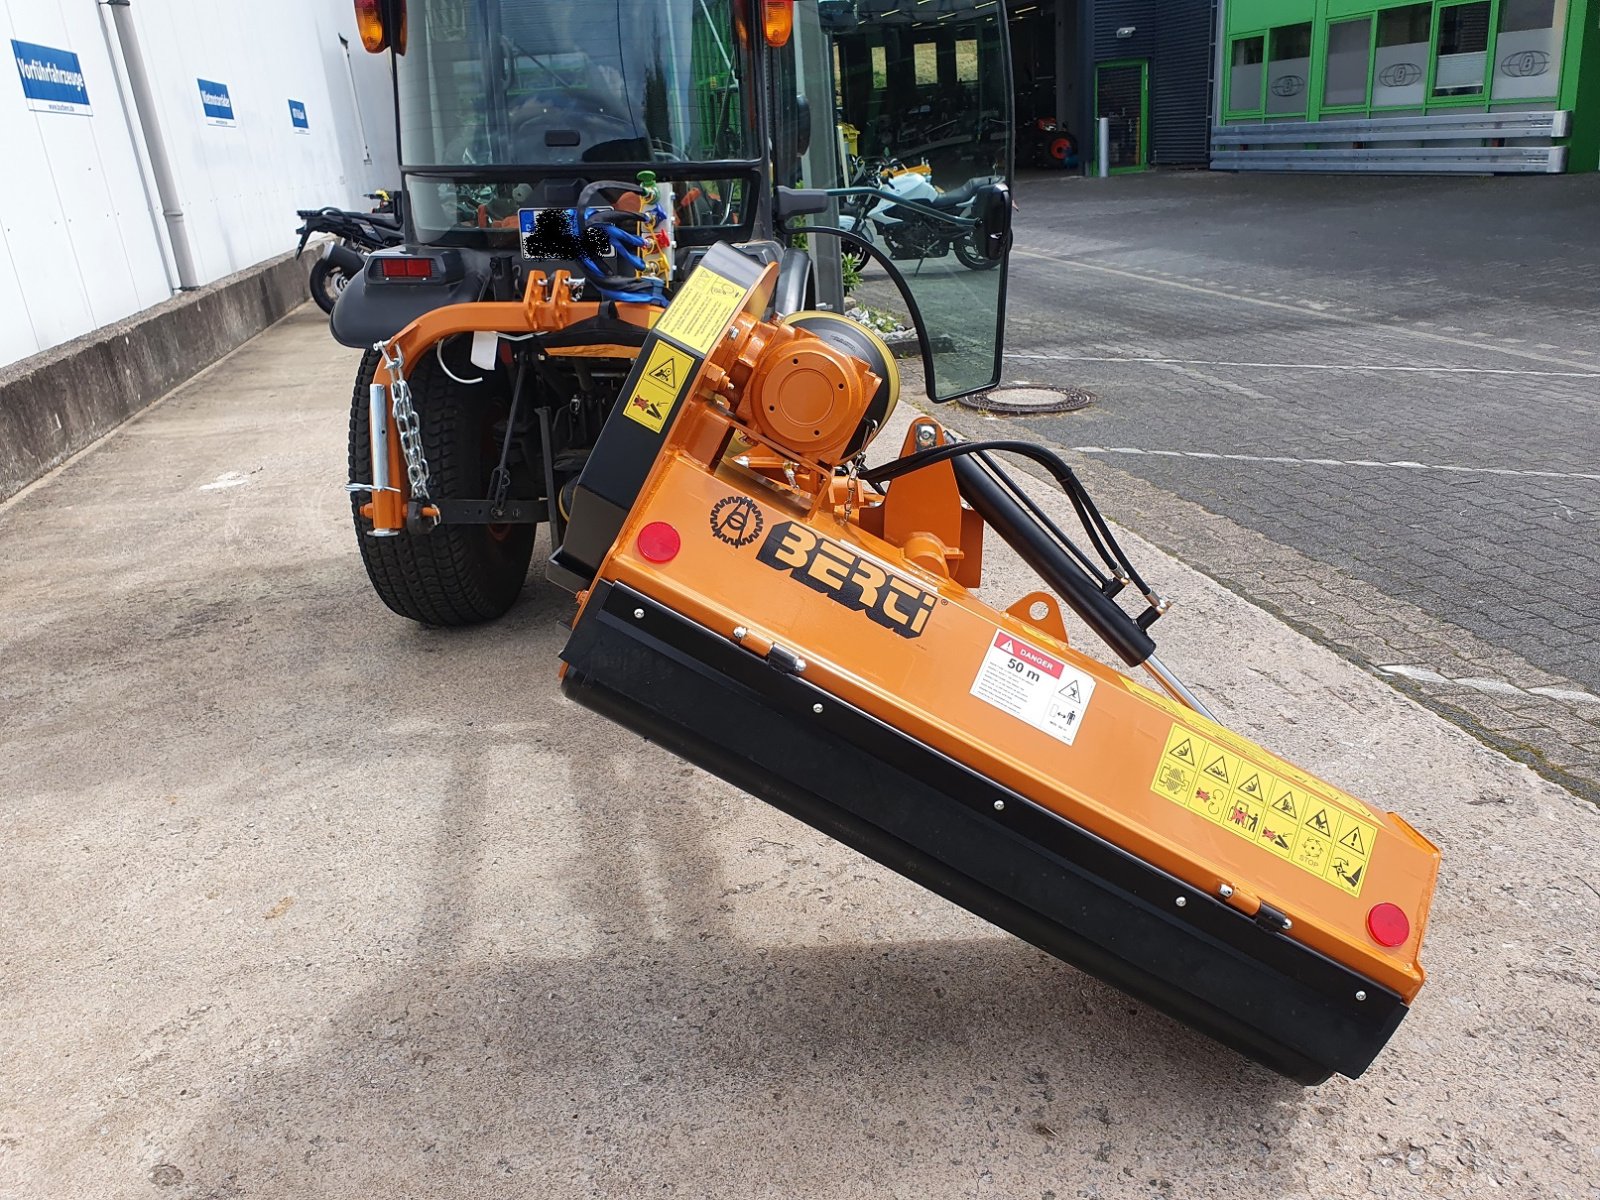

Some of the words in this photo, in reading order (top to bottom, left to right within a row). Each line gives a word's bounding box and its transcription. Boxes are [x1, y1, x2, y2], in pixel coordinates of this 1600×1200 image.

[17, 57, 84, 91] Vorführfahrzeuge
[1007, 658, 1024, 673] 50
[1026, 669, 1040, 682] m
[1020, 648, 1054, 671] DANGER
[1299, 854, 1319, 867] STOP
